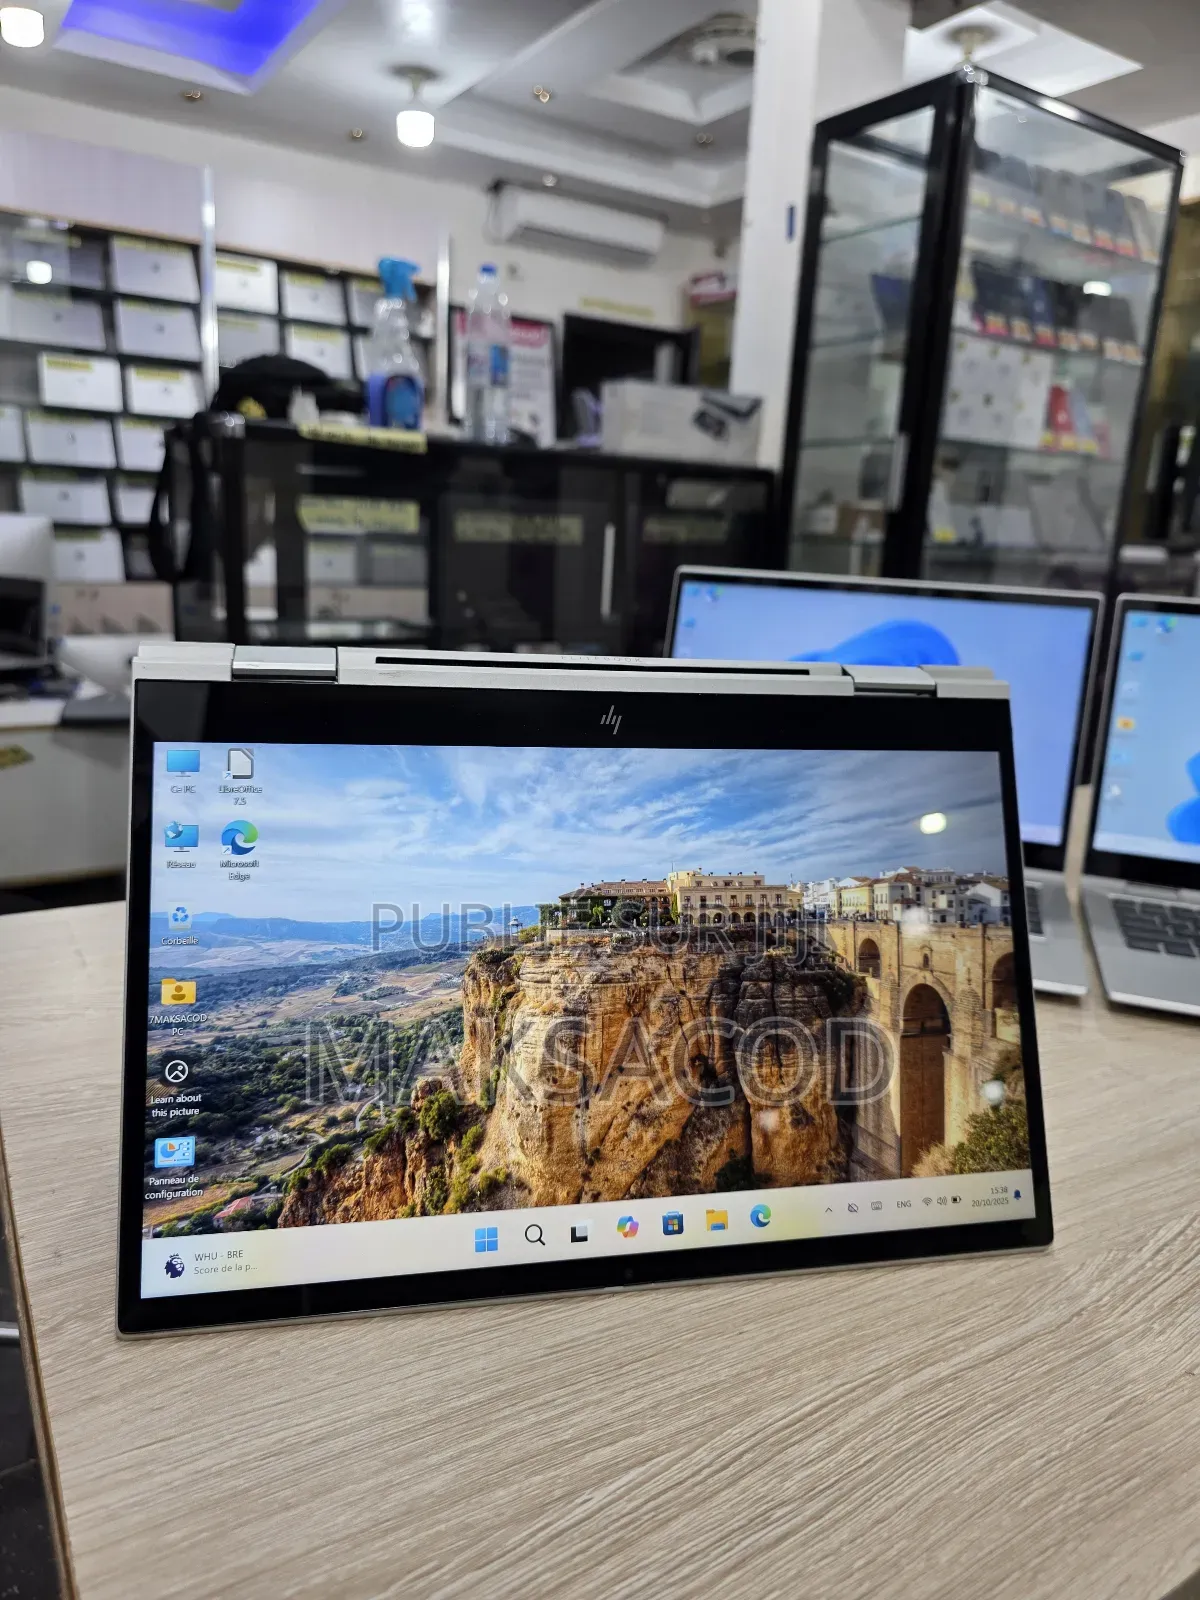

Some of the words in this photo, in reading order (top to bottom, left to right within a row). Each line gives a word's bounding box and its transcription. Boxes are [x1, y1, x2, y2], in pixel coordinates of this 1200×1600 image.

[170, 785, 182, 794] Ce
[183, 785, 196, 794] PC
[218, 785, 263, 794] LibreOffice
[233, 797, 247, 806] 7.5
[166, 860, 197, 869] Réseau
[219, 860, 260, 869] Microsoft
[228, 872, 251, 882] Edge
[161, 935, 199, 946] Corbeille
[149, 1013, 207, 1025] 7MAKSACOD
[172, 1027, 184, 1036] PC
[150, 1095, 174, 1104] Learn
[176, 1093, 202, 1103] about
[151, 1109, 168, 1118] this
[170, 1107, 200, 1118] picture
[149, 1177, 186, 1186] Panneau
[187, 1174, 200, 1183] de
[144, 1188, 204, 1200] configuration
[896, 1199, 912, 1209] ENG
[194, 1251, 218, 1261] WHU
[227, 1249, 244, 1259] BRE
[194, 1265, 219, 1275] Score
[221, 1264, 233, 1273] de
[235, 1262, 243, 1271] la
